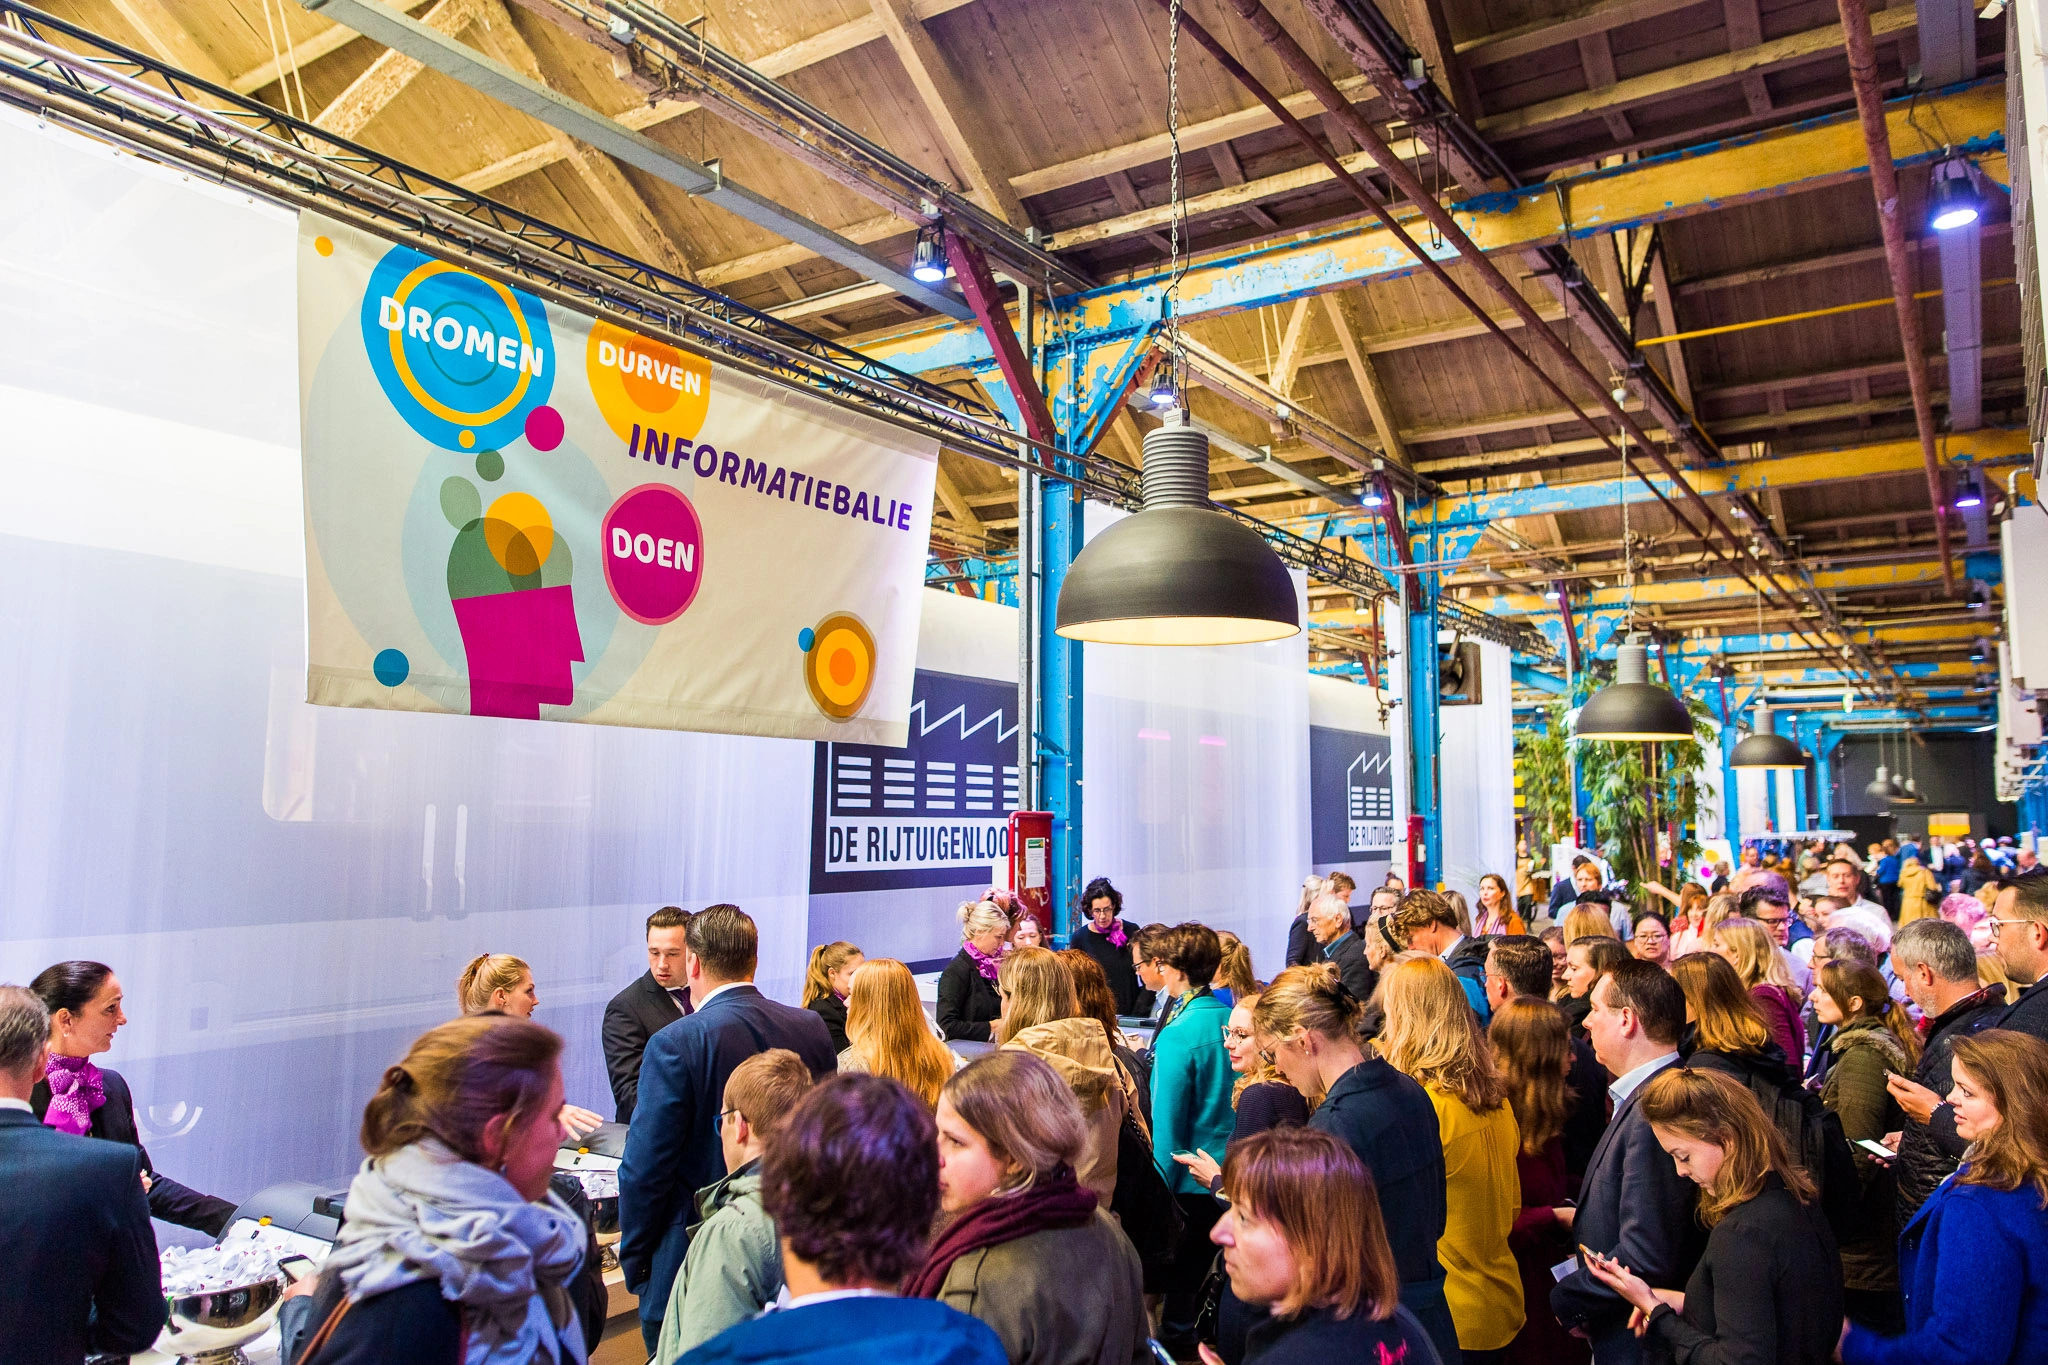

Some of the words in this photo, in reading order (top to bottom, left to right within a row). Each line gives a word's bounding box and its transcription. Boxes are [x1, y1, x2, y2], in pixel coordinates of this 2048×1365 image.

[378, 295, 544, 379] DROMEN
[598, 339, 702, 397] DURVEN
[628, 423, 914, 531] INFORMATIEBALIE
[612, 526, 695, 572] DOEN
[829, 826, 858, 863] DE
[866, 826, 1019, 862] RIJTUIGENLOO
[1350, 826, 1359, 846] DE
